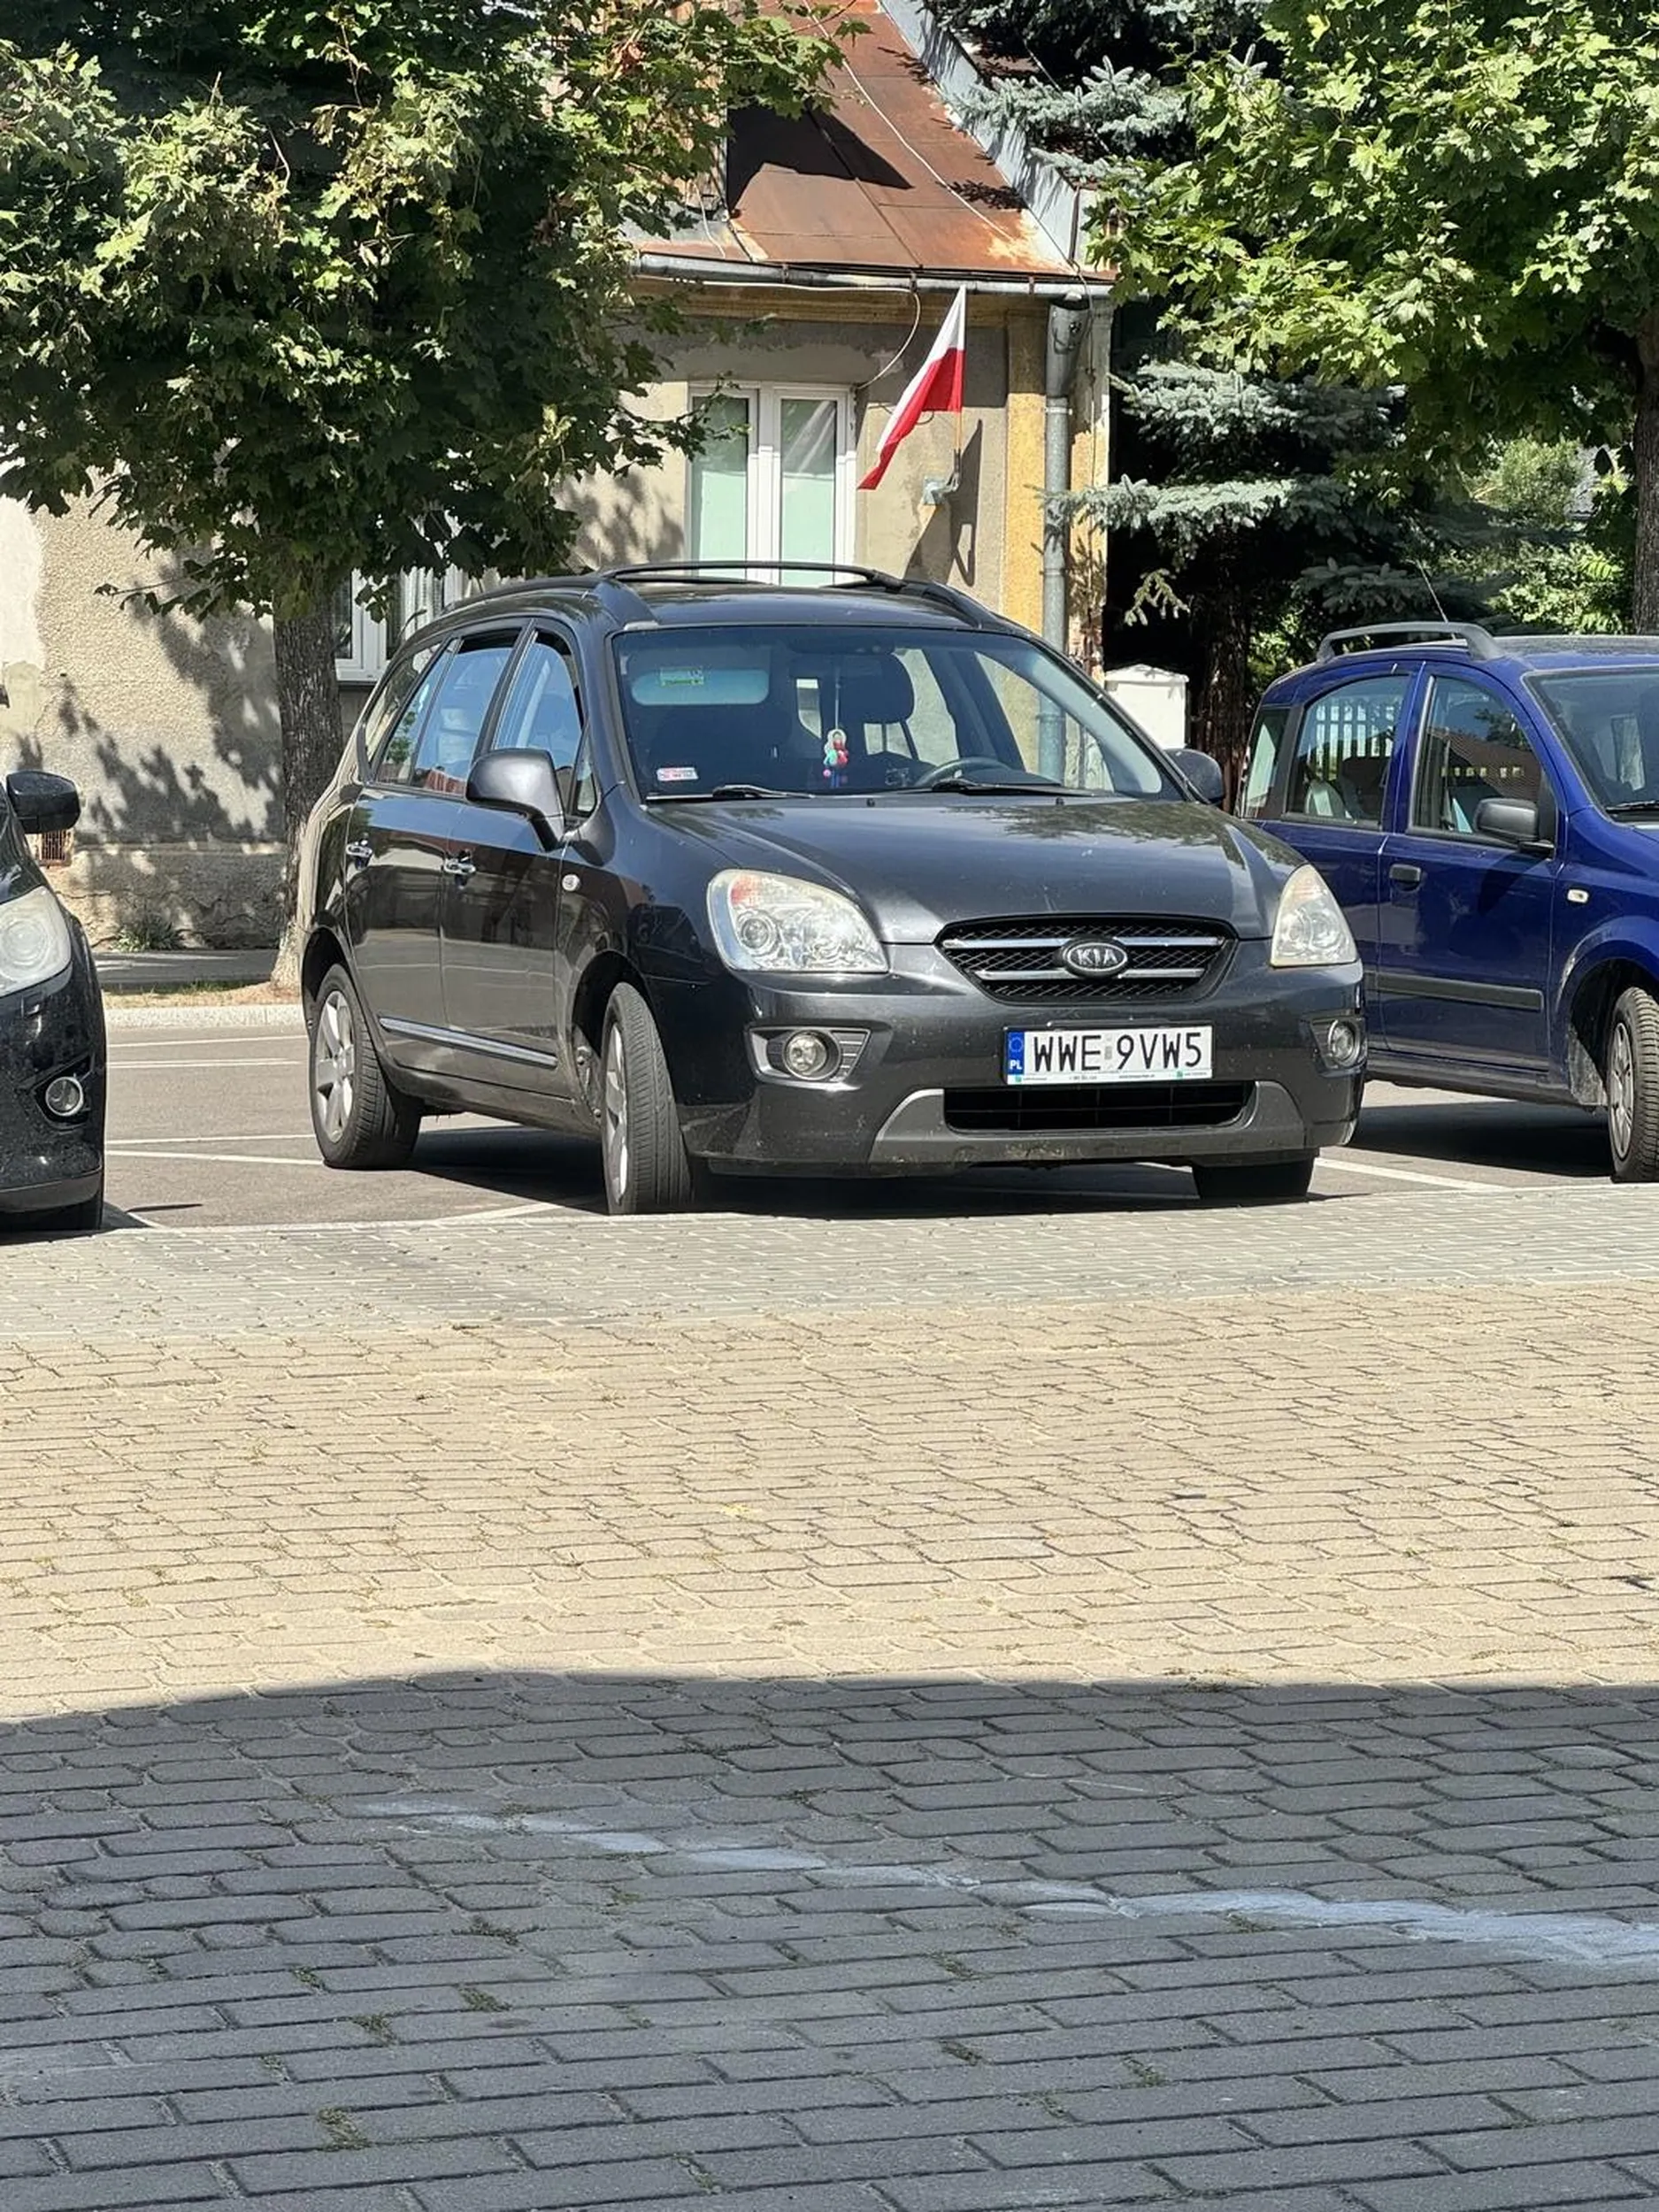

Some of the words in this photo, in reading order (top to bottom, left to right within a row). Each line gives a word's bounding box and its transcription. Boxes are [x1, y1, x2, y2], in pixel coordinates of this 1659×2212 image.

[1076, 949, 1117, 966] KIA
[1033, 1034, 1102, 1072] WWE
[1117, 1032, 1202, 1071] 9VW5
[1009, 1059, 1023, 1071] PL
